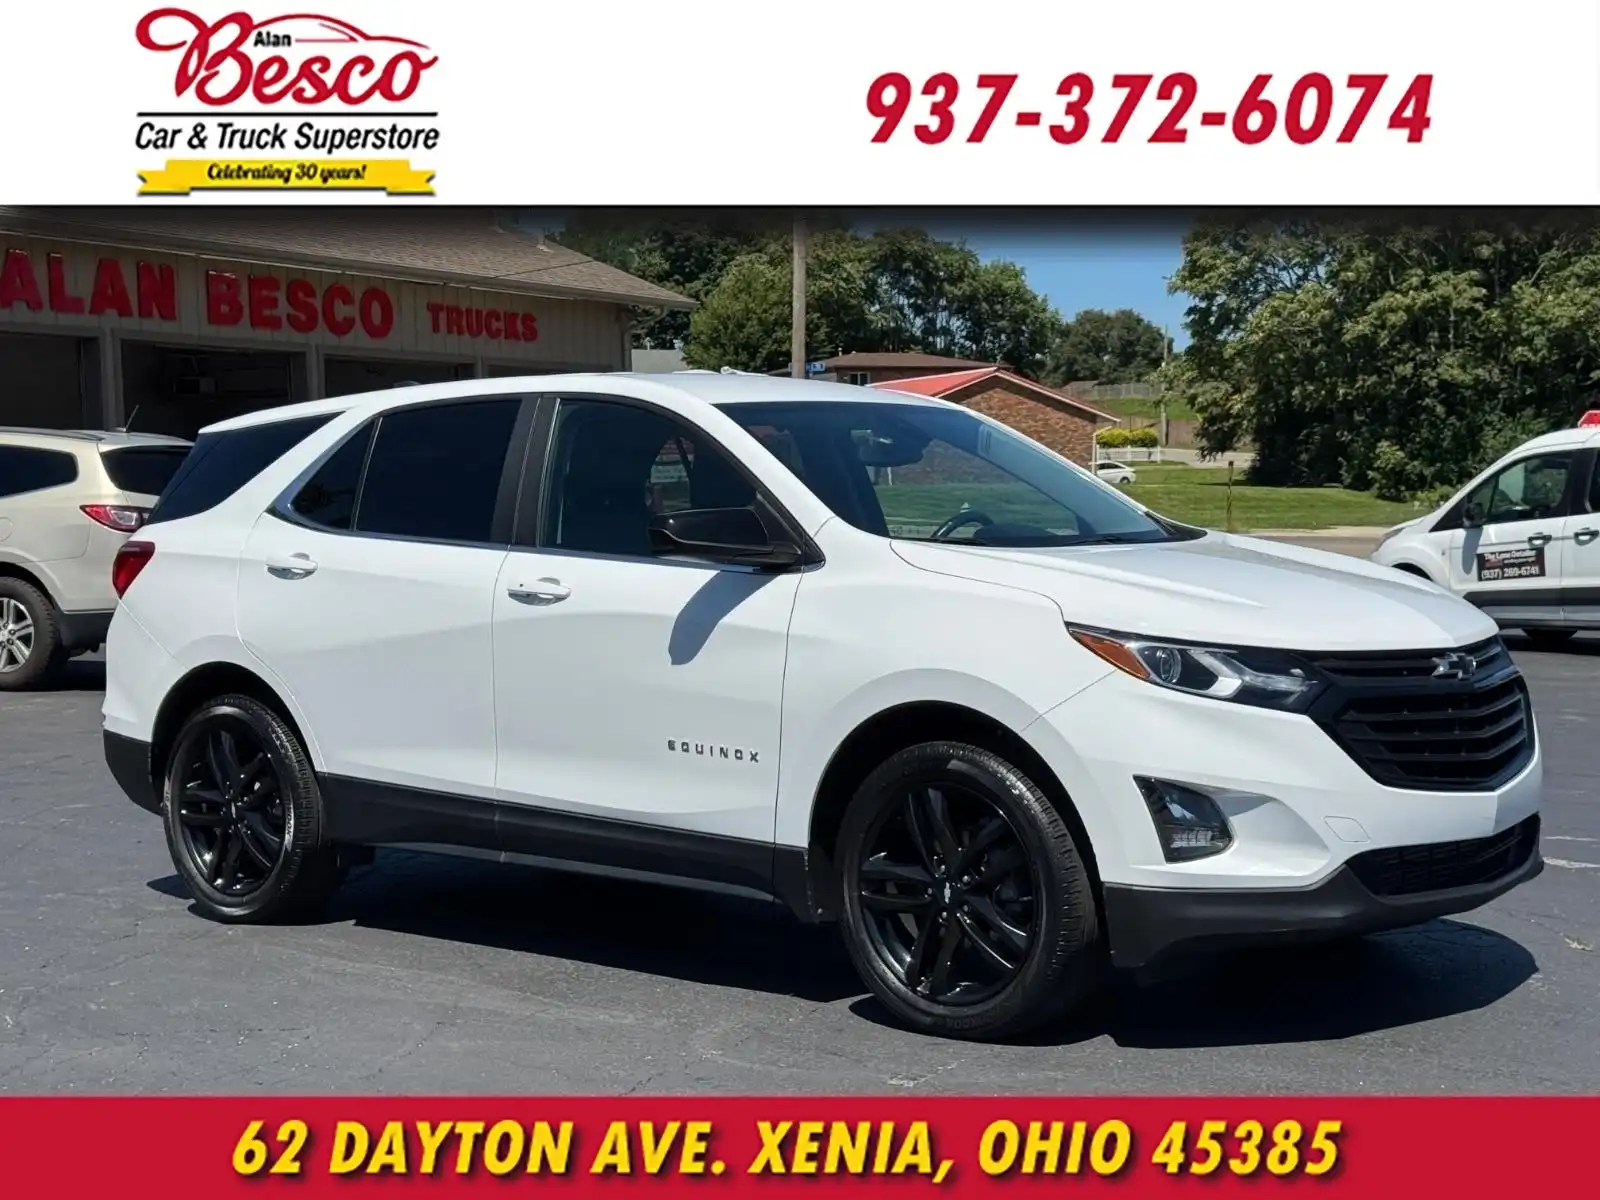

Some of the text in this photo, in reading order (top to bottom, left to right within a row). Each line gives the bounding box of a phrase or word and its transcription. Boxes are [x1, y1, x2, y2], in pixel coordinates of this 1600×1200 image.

[0, 250, 538, 342] ALAN BESCO TRUCKS
[667, 739, 759, 763] EQUINOX
